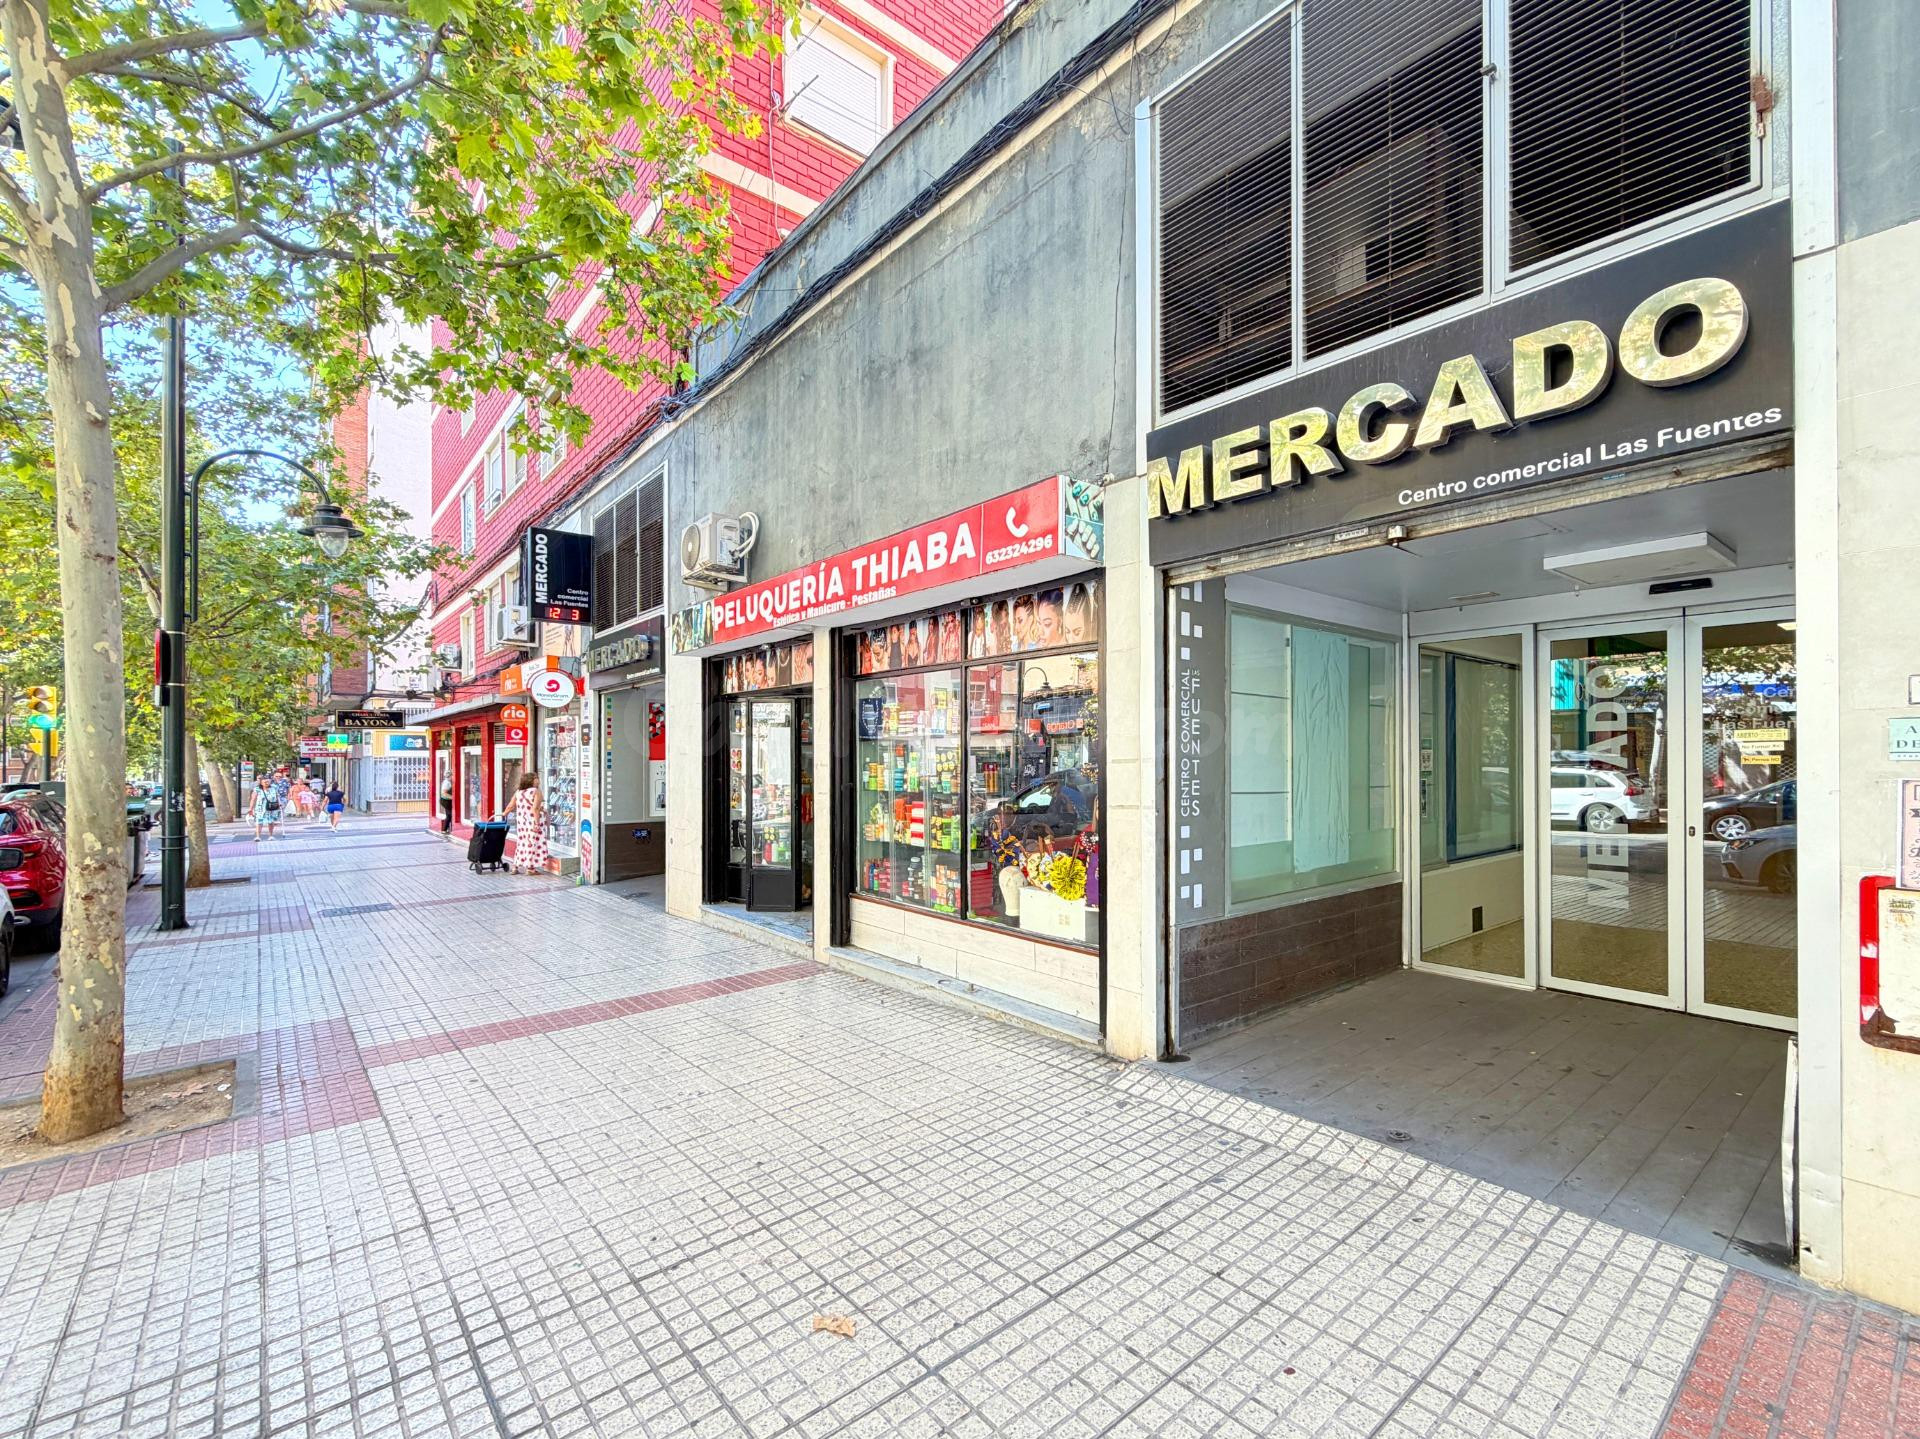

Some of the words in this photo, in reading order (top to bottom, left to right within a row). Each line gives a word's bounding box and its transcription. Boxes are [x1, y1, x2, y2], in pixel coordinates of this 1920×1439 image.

[1147, 277, 1750, 520] MERCADO
[1398, 478, 1468, 507] Centro
[1472, 446, 1592, 490] comercial
[1599, 435, 1649, 461] Las
[1657, 406, 1782, 448] Fuentes
[535, 533, 548, 604] MERCADO
[985, 534, 1054, 565] 632324296
[557, 594, 589, 602] comercial
[567, 588, 589, 596] Centro
[713, 562, 845, 632] PELUQUERÍA
[851, 521, 977, 592] THIABA
[563, 600, 589, 608] Fuentes
[806, 599, 847, 620] Manicure
[851, 585, 897, 608] Pestañas
[344, 718, 396, 727] BAYONA
[503, 706, 526, 719] ria
[1180, 668, 1191, 753] COMERCIAL
[1191, 677, 1201, 817] FUENTES
[1180, 757, 1191, 817] CENTRO
